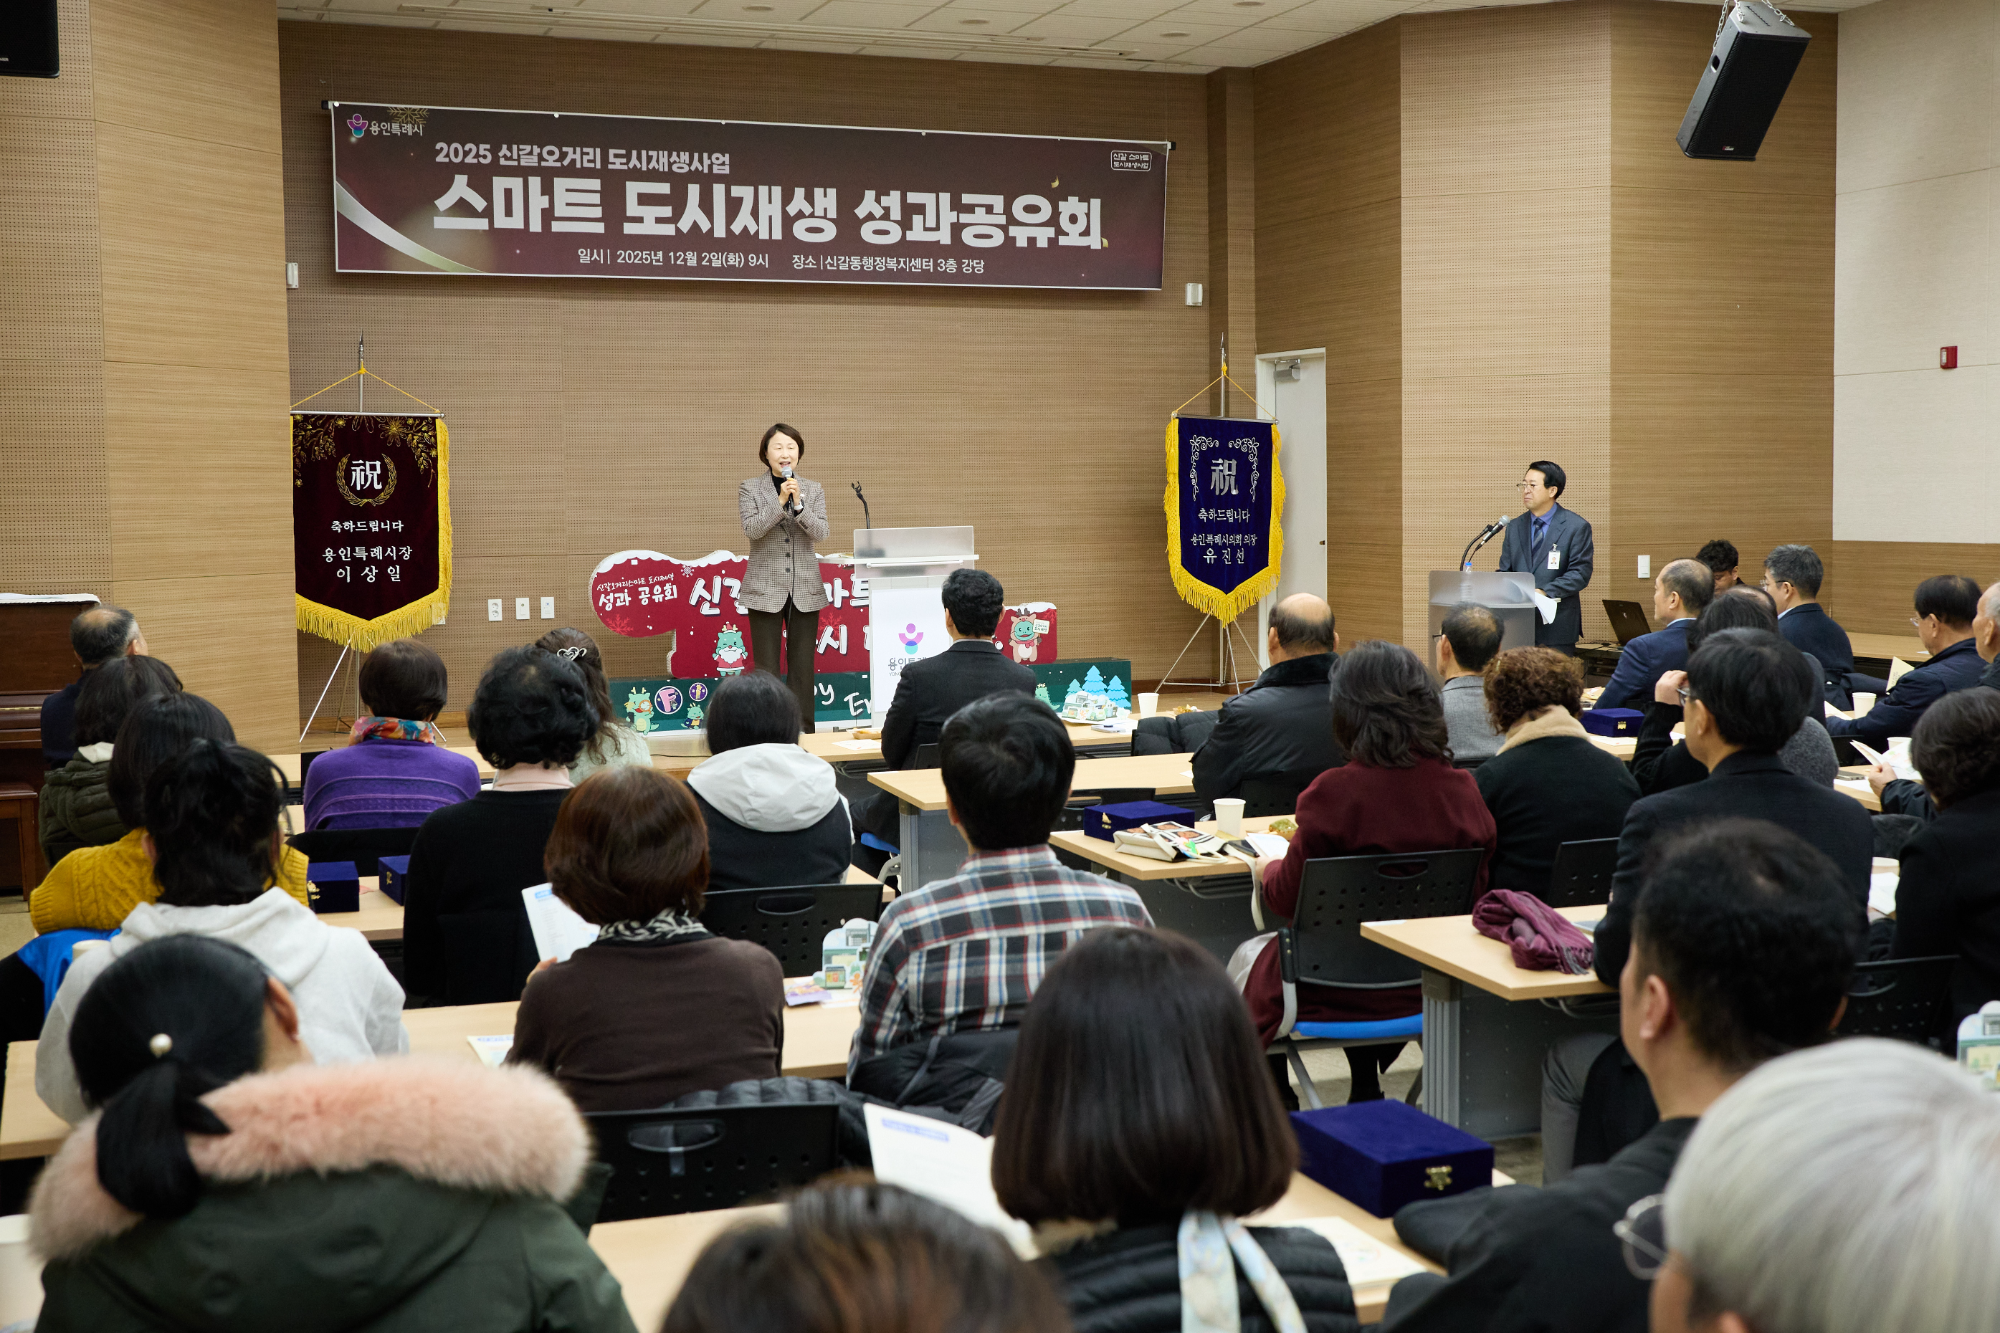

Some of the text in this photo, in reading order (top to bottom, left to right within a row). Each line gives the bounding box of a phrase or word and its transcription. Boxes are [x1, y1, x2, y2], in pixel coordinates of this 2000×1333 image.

[369, 120, 423, 137] 용인특례시
[435, 142, 731, 174] 2025 신갈오거리 도시재생사업
[433, 174, 1102, 249] 스마트 도시재생 성과공유회
[616, 250, 663, 266] 2025년
[668, 251, 697, 267] 12월
[701, 252, 745, 268] 2일(화)
[748, 254, 769, 268] 9시
[825, 255, 933, 273] 신갈동행정복지센터
[937, 258, 957, 273] 3층
[961, 259, 985, 274] 강당
[350, 459, 383, 491] 祝
[1210, 458, 1239, 496] 祝
[1198, 508, 1250, 523] 축하드립니다
[331, 520, 404, 533] 축하드립니다
[322, 545, 413, 563] 용인특례시장
[599, 582, 678, 611] 성과 공유회
